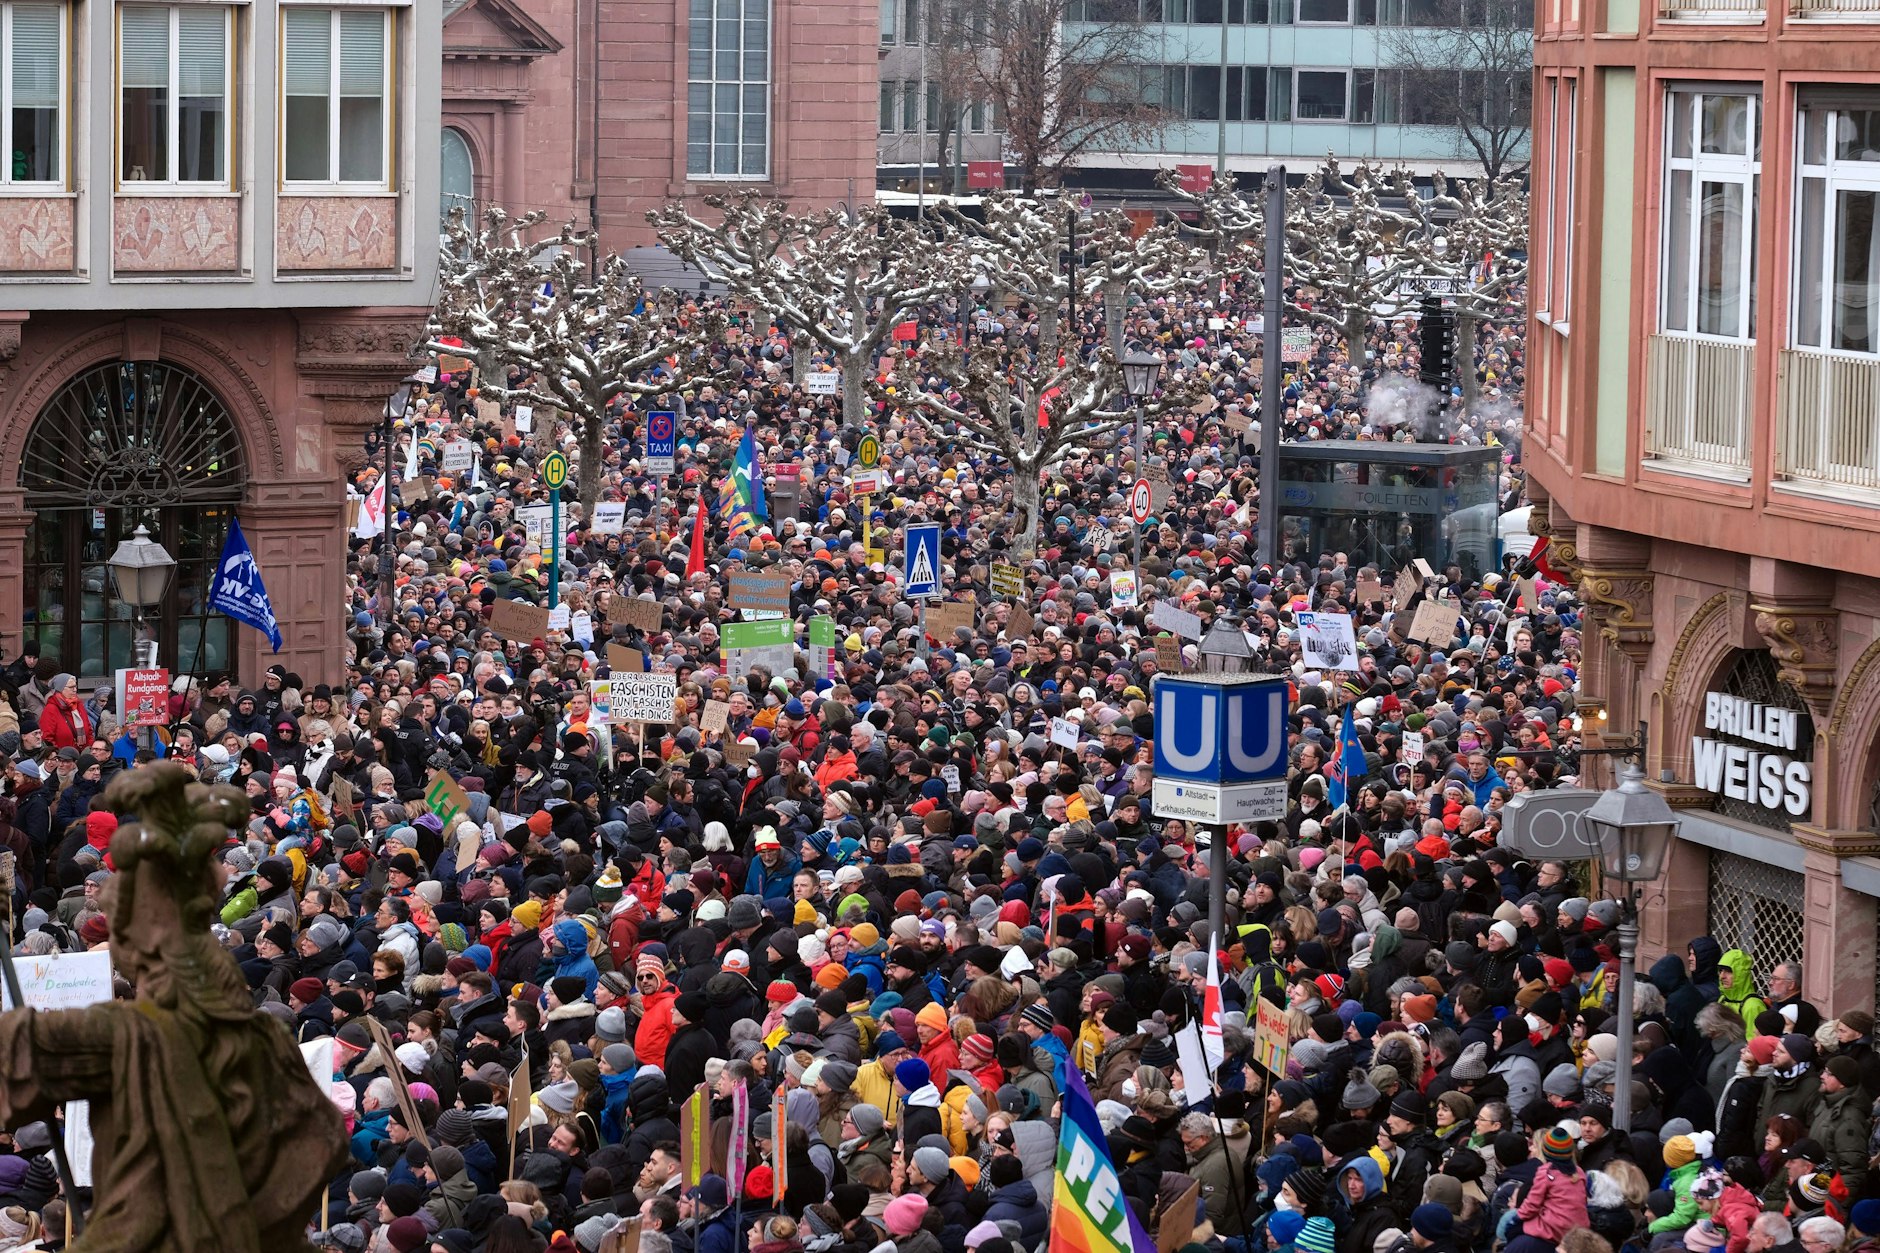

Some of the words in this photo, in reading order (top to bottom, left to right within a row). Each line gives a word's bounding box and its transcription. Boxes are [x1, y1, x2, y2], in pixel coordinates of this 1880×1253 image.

[1282, 328, 1310, 336] RESPECT
[650, 443, 672, 453] TAXI
[864, 444, 873, 461] H
[551, 461, 560, 481] H
[1136, 491, 1147, 511] 40
[1358, 491, 1429, 506] TOILETTEN
[1093, 526, 1108, 539] FCK
[1119, 587, 1131, 596] AFD
[507, 604, 544, 619] Alternative
[1158, 604, 1193, 622] SMASH
[1157, 613, 1199, 637] FASCISM
[1300, 615, 1314, 624] AfD
[1428, 625, 1450, 644] 1933
[133, 671, 162, 682] Altstadt-
[127, 682, 167, 694] Rundgänge
[610, 682, 675, 699] FASCHISTEN
[611, 697, 630, 707] TUN
[613, 708, 646, 719] TISCHE
[647, 709, 672, 721] DINGE
[1705, 691, 1798, 751] BRILLEN
[1161, 690, 1217, 773] U
[1228, 691, 1283, 773] U
[1405, 749, 1421, 760] JETZT
[550, 762, 570, 771] POLIZEI
[1693, 736, 1811, 816] WEISS
[1184, 789, 1209, 801] Altstadt
[1263, 787, 1276, 796] Zeil
[1236, 797, 1276, 808] Hauptwache
[1252, 808, 1267, 817] 40m
[1379, 832, 1401, 840] POLIZ
[34, 959, 59, 982] Wer
[24, 981, 40, 990] der
[45, 978, 97, 991] Demokratie
[1258, 1003, 1268, 1028] Nie
[1269, 1014, 1289, 1038] wieder
